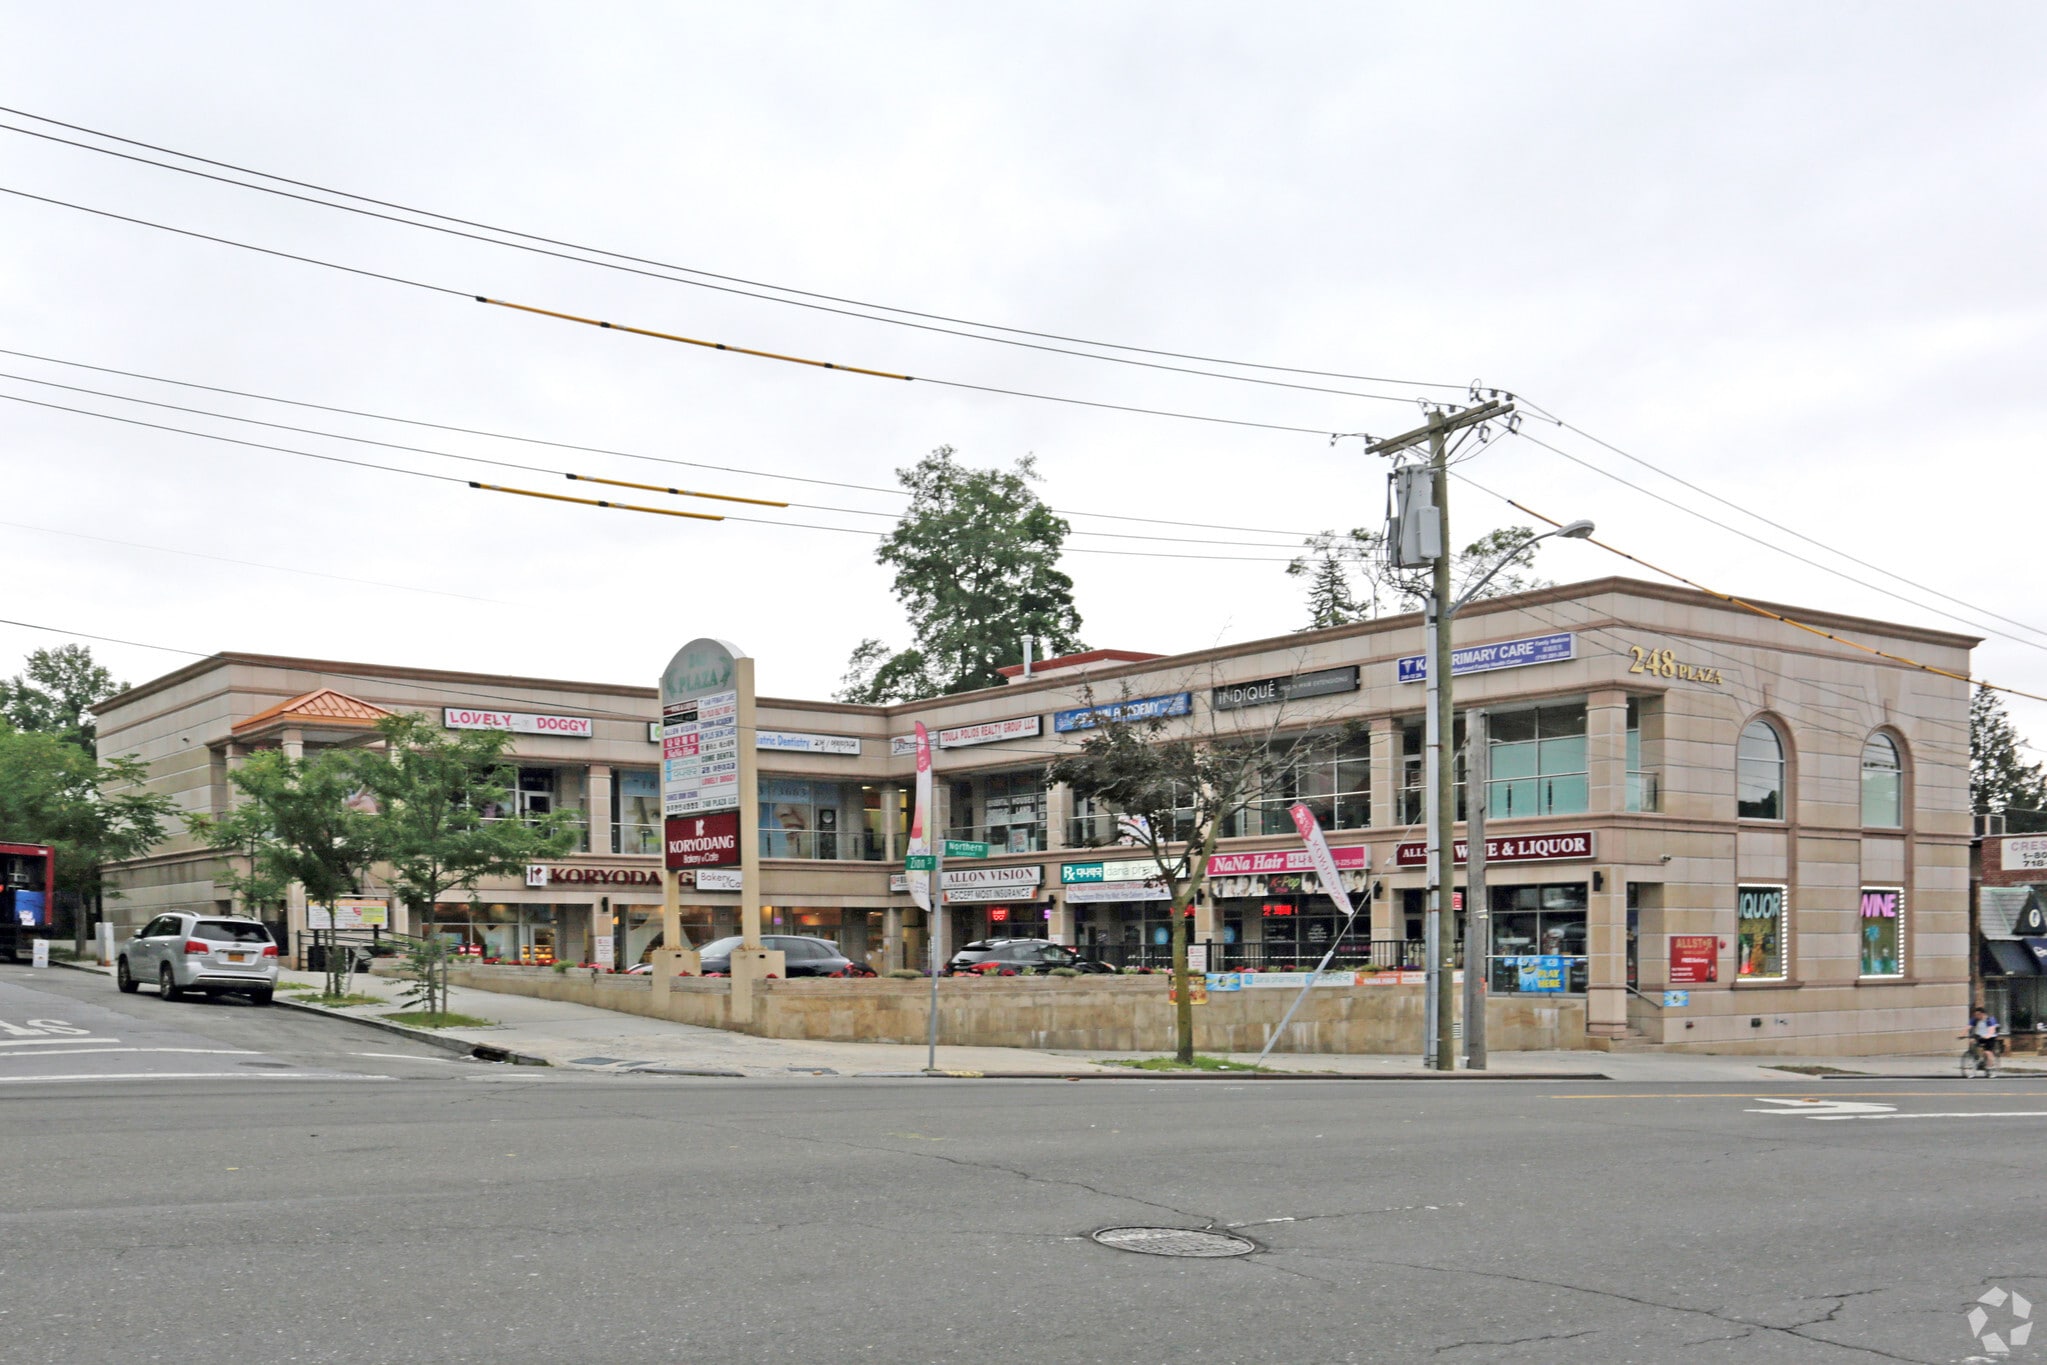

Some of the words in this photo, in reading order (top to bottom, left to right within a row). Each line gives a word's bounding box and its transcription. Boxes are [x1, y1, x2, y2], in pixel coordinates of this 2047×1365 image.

[1452, 648, 1497, 666] RIMARY
[1499, 642, 1535, 659] CARE
[1629, 645, 1676, 679] 248
[1676, 664, 1723, 685] PLAZA
[679, 669, 718, 694] PLAZA
[450, 711, 512, 727] LOVELY
[536, 717, 588, 732] DOGGY
[981, 724, 1001, 737] REALTY
[1004, 720, 1022, 733] GROUP
[777, 735, 810, 750] Dentistry
[716, 751, 736, 760] DENTAL
[712, 798, 726, 807] PLAZA
[669, 834, 735, 854] KORYODANG
[949, 842, 983, 852] Northern
[1402, 847, 1429, 859] ALLS
[1455, 844, 1499, 859] WE
[1502, 842, 1514, 856] &
[1518, 838, 1586, 857] LIQUOR
[704, 852, 719, 862] Cafe
[910, 857, 926, 869] Zion
[1214, 856, 1250, 872] NaNa
[1253, 854, 1285, 870] Hair
[551, 868, 695, 886] KORYODAG
[701, 872, 731, 883] Bakery
[949, 871, 987, 883] ALLON
[990, 868, 1034, 881] VISION
[1269, 875, 1300, 891] K-Pop
[729, 879, 741, 888] Ca
[950, 890, 974, 900] ACCEPT
[975, 889, 993, 899] MOST
[994, 887, 1031, 898] INSURANCE
[1739, 892, 1782, 919] IQUOR
[1538, 969, 1560, 978] PLAY
[1538, 979, 1561, 988] HERE
